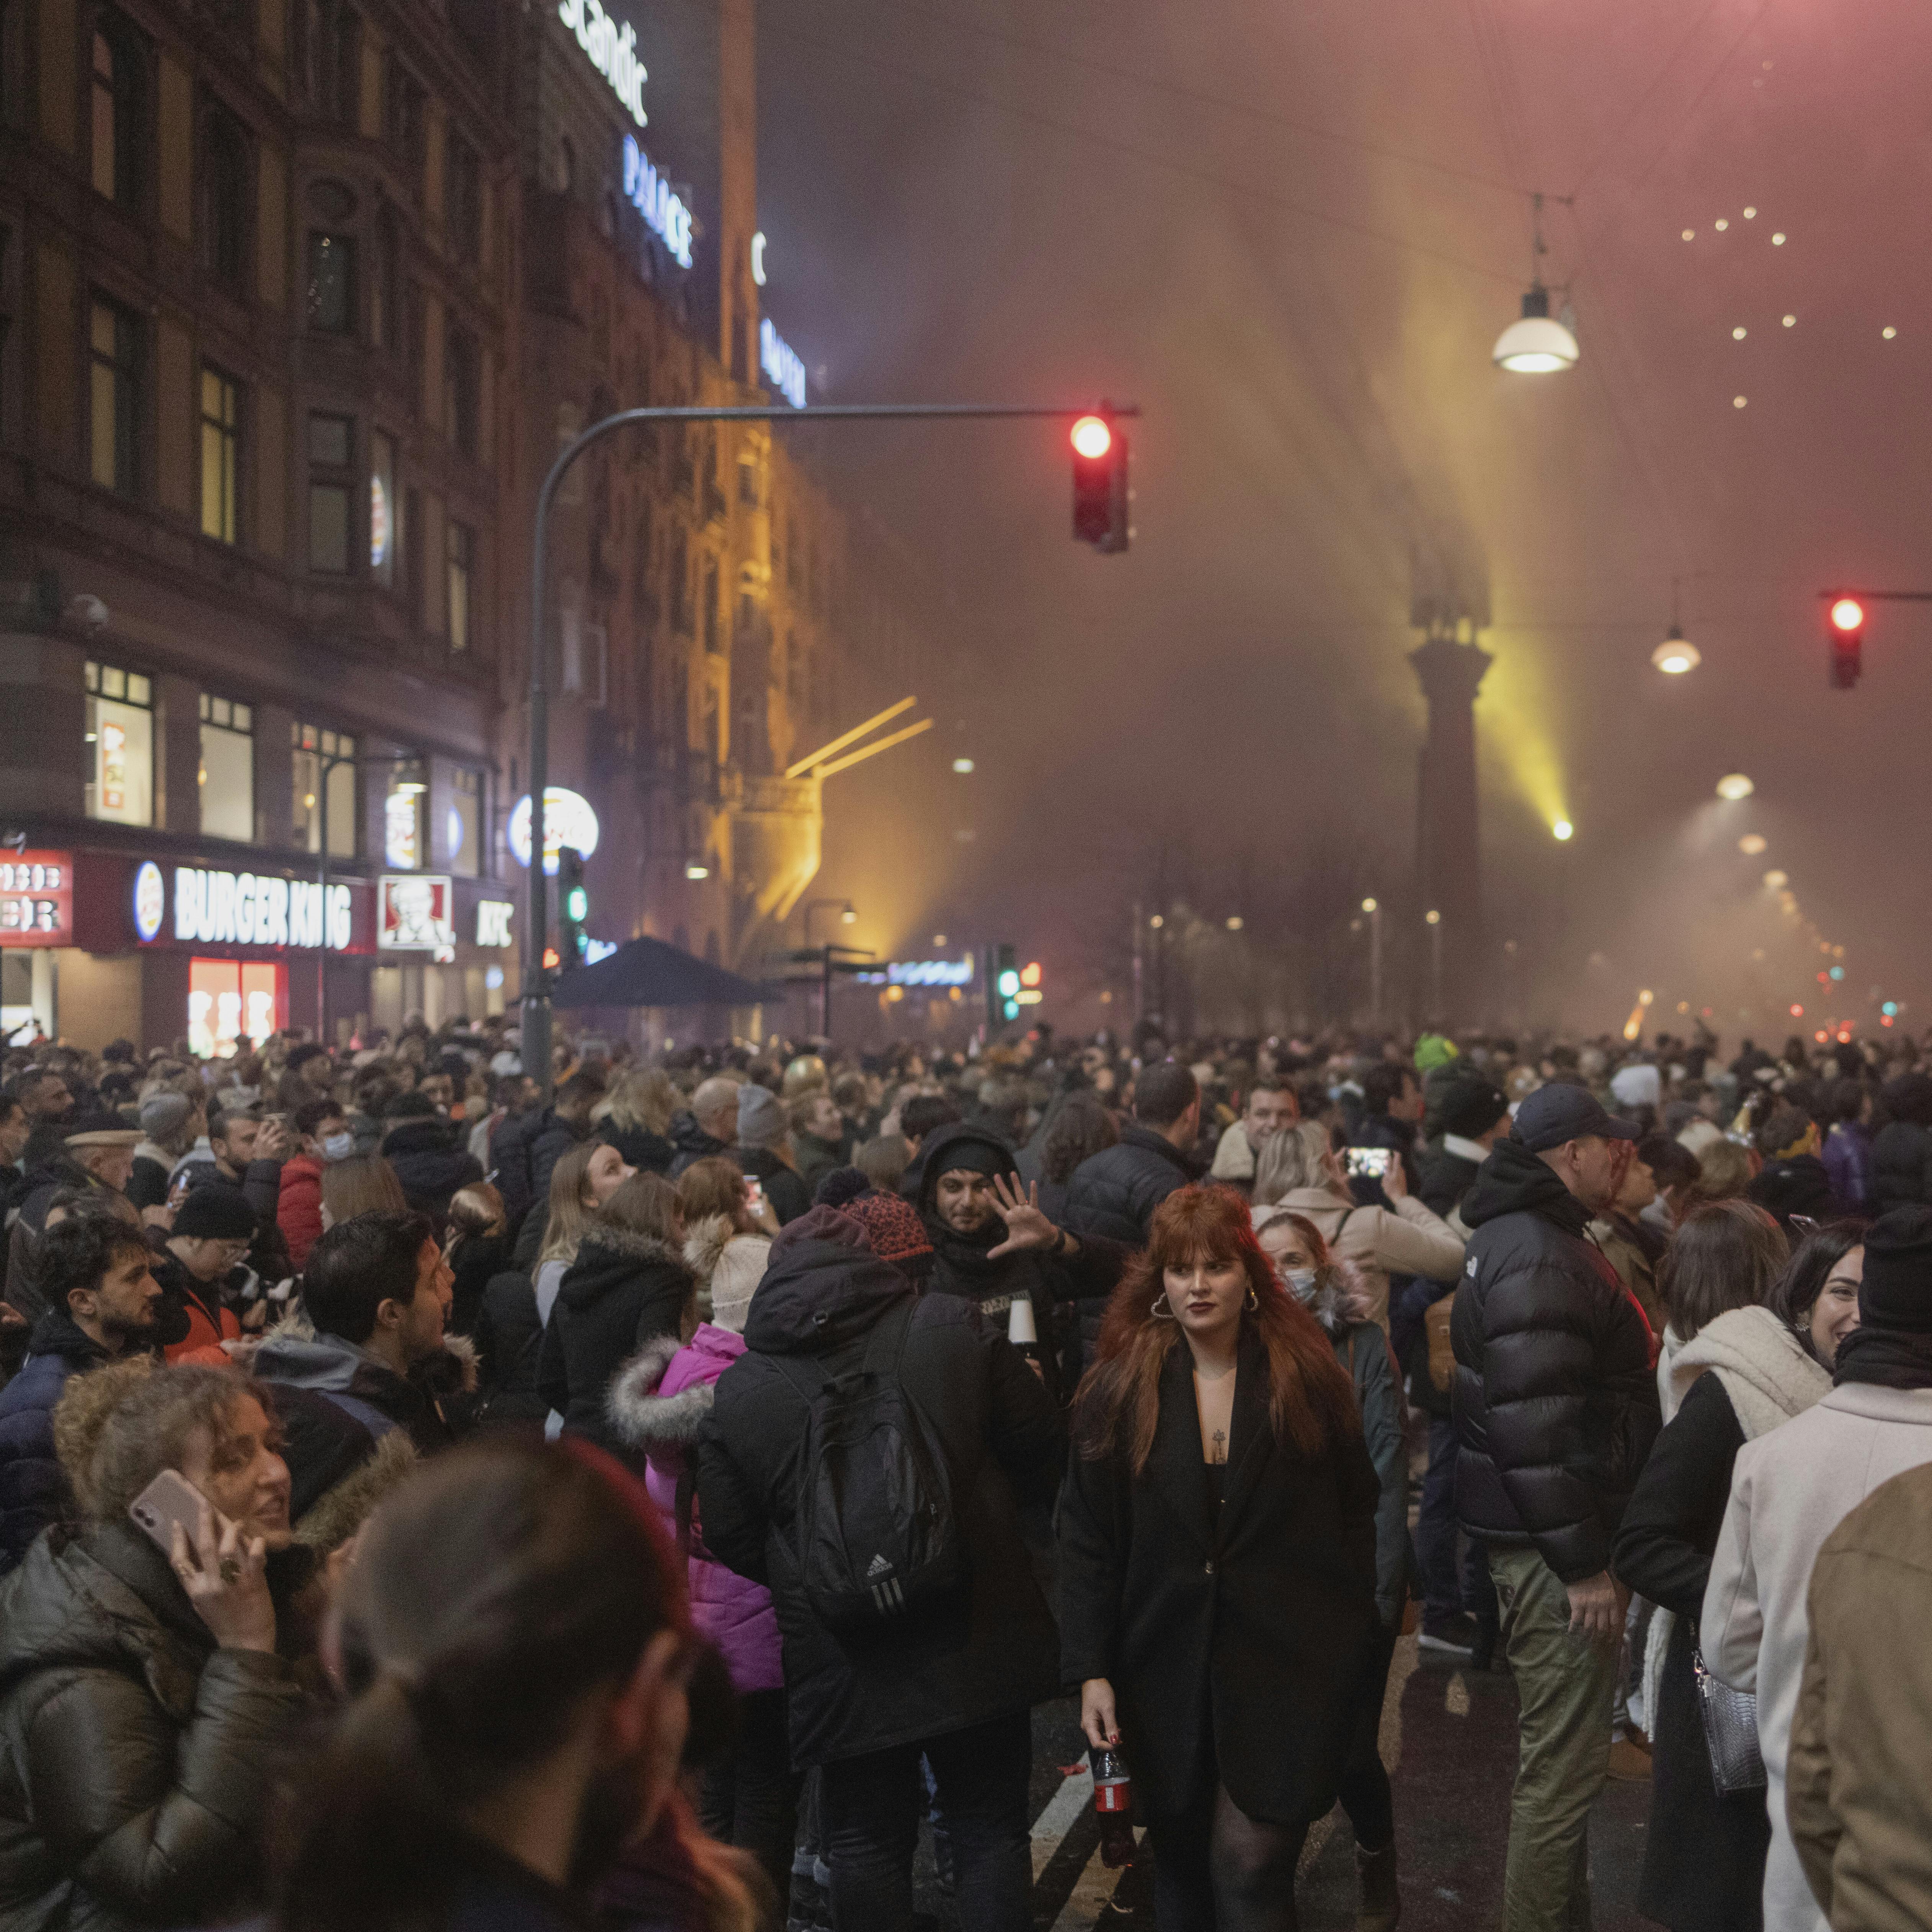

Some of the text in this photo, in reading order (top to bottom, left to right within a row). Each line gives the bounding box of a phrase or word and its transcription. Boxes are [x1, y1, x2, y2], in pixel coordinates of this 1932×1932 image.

[175, 867, 288, 945] BURGER
[289, 880, 351, 950] KING
[477, 900, 514, 948] KFC
